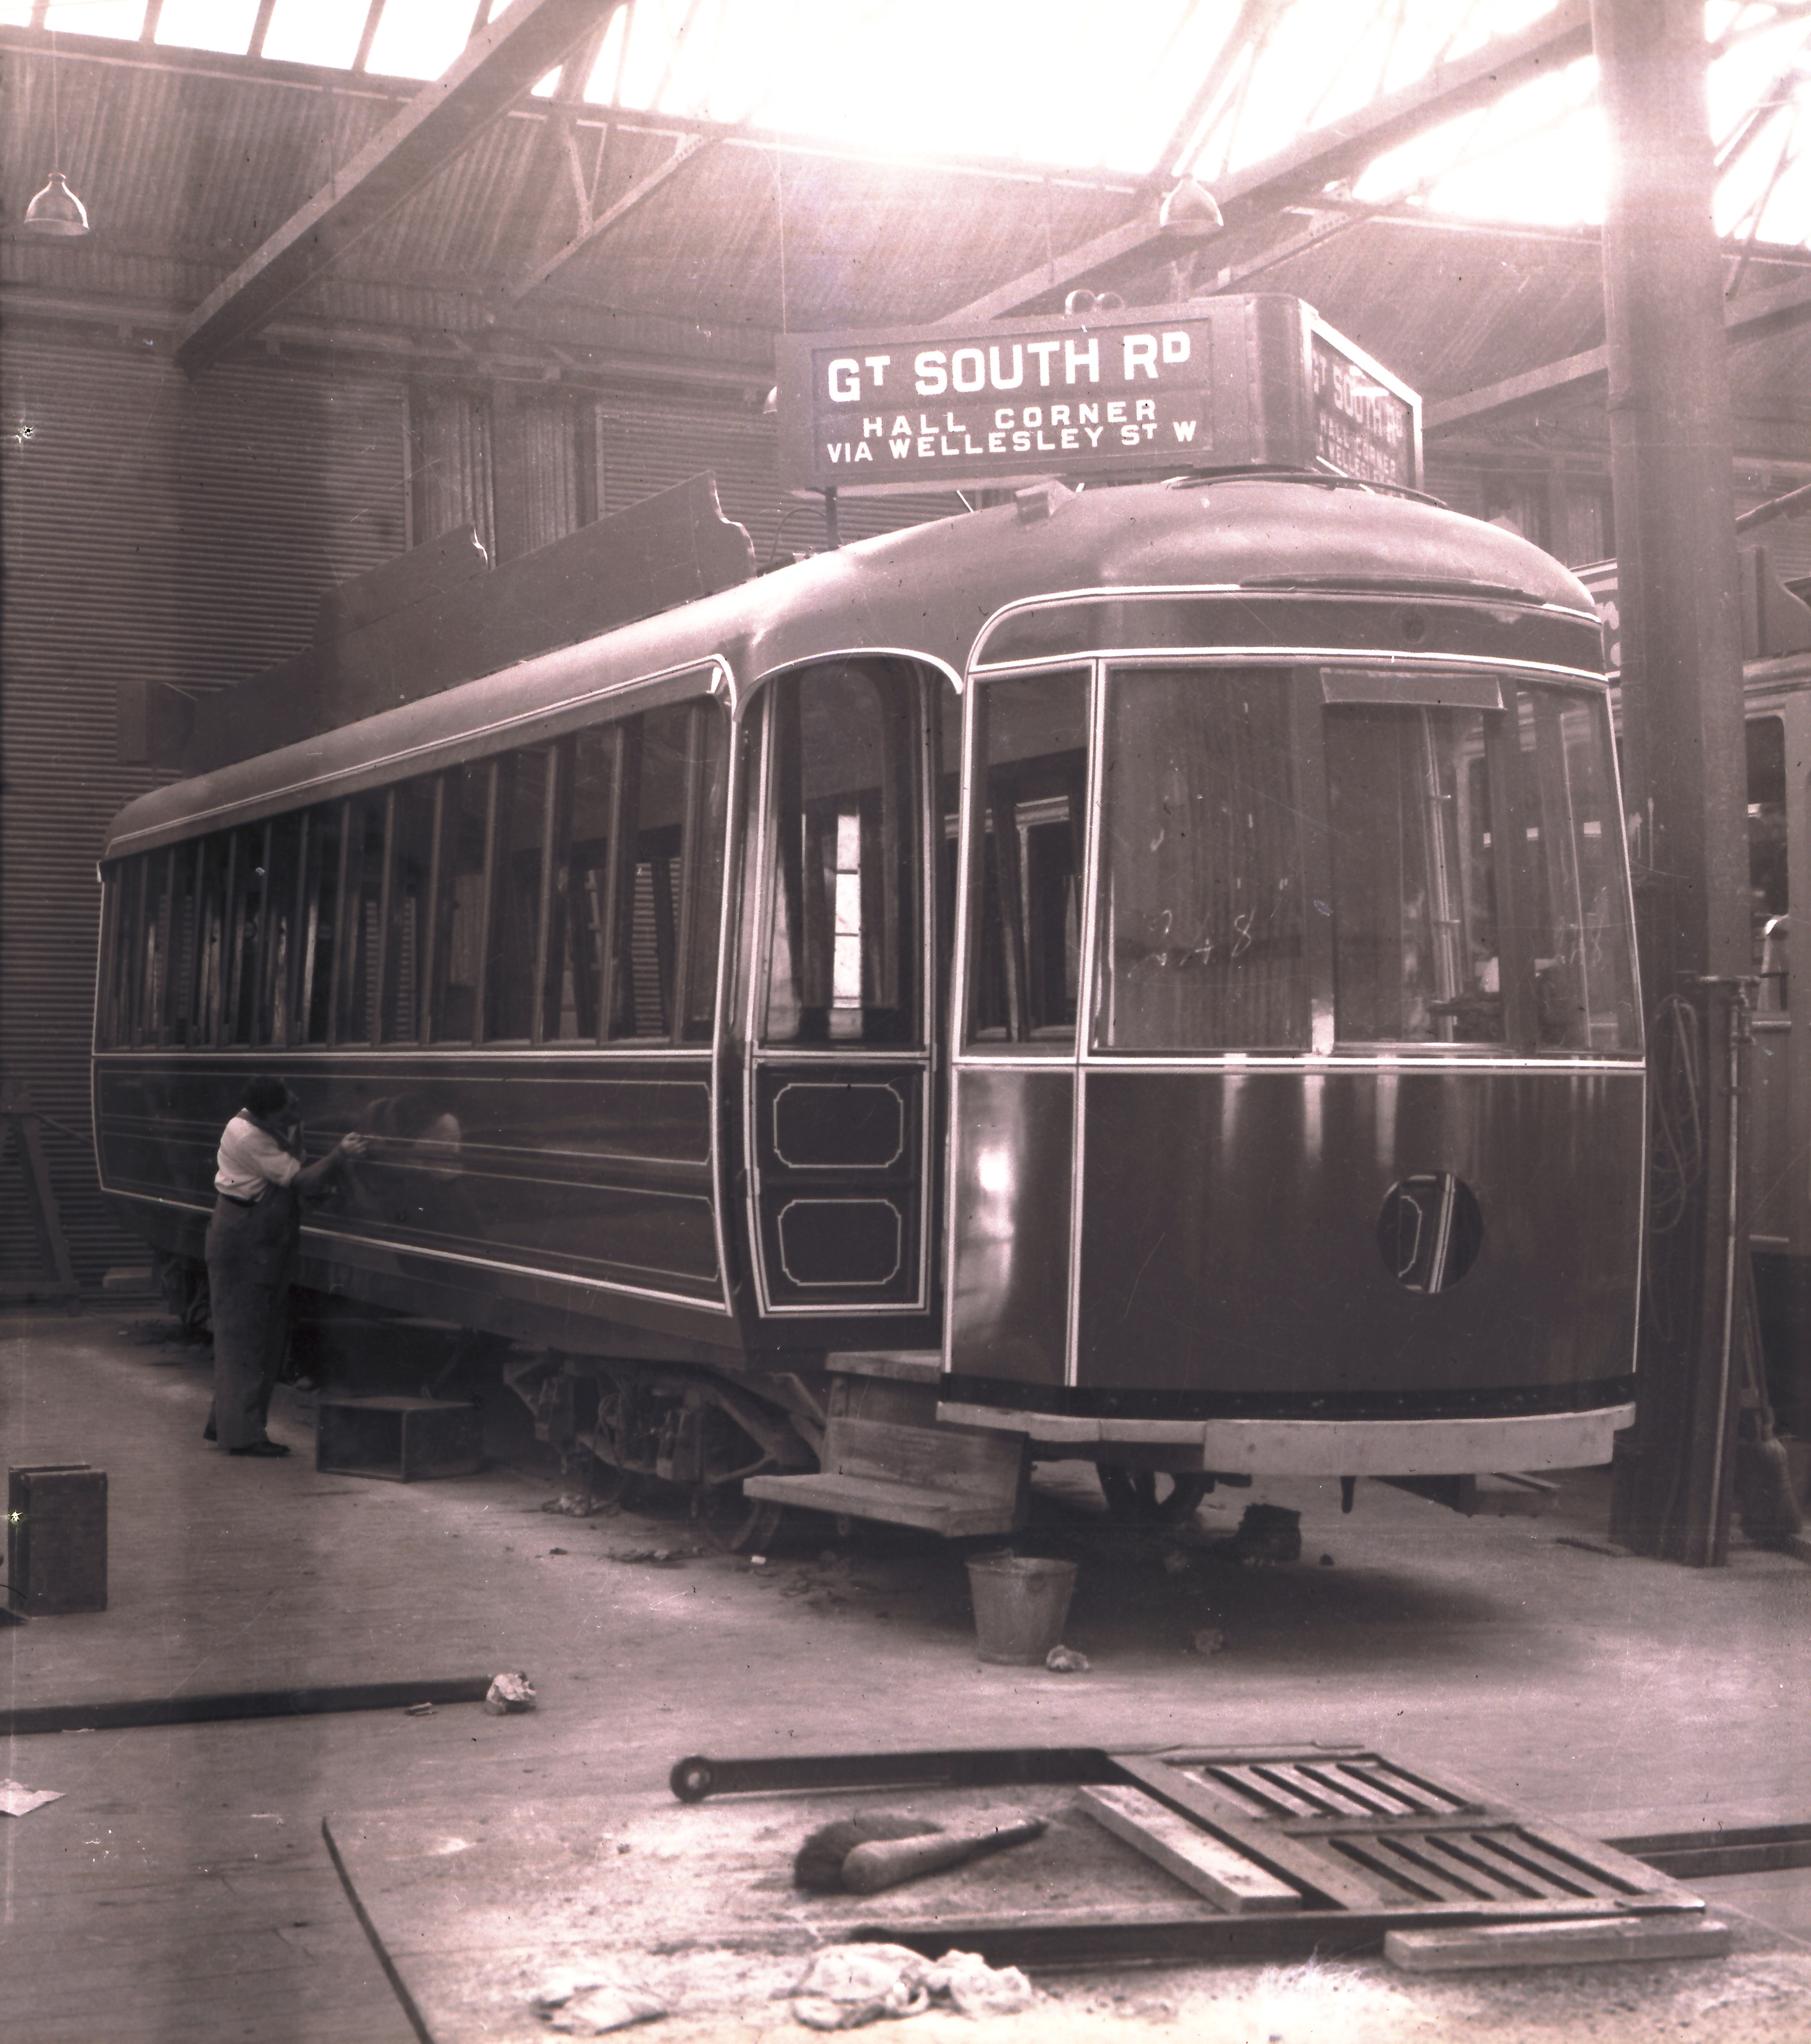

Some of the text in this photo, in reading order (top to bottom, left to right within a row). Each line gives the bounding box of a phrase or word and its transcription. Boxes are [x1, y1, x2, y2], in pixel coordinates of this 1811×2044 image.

[914, 338, 1100, 395] SOUTH
[863, 399, 1156, 438] HALL CORNER
[1333, 364, 1383, 436] SOUTH
[828, 441, 873, 463] VIA
[889, 426, 1103, 459] WELLESLEY
[1173, 421, 1196, 442] W
